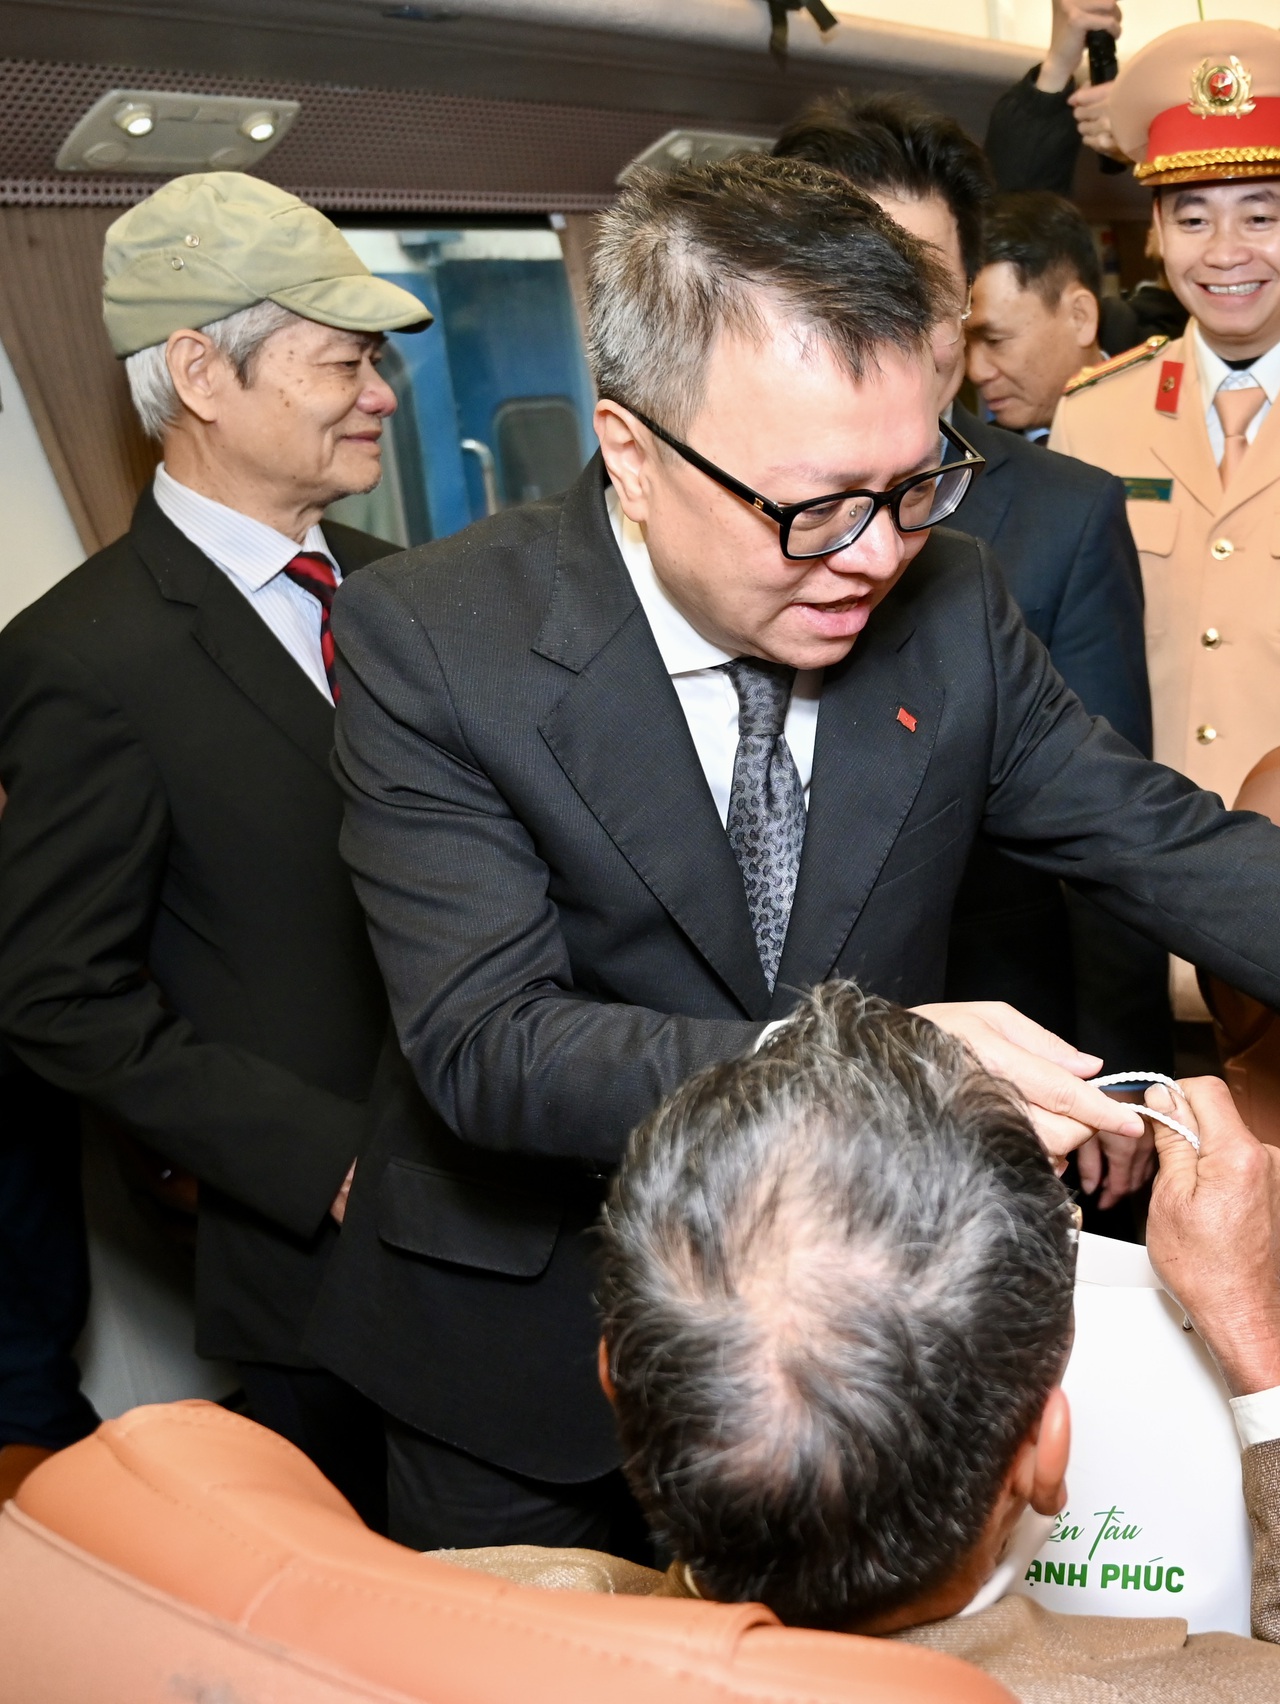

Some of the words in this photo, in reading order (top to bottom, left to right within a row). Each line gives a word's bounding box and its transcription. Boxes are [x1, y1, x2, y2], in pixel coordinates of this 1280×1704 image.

[1088, 1505, 1143, 1561] Tàu
[1024, 1559, 1088, 1587] ẠNH
[1100, 1556, 1185, 1593] PHÚC
